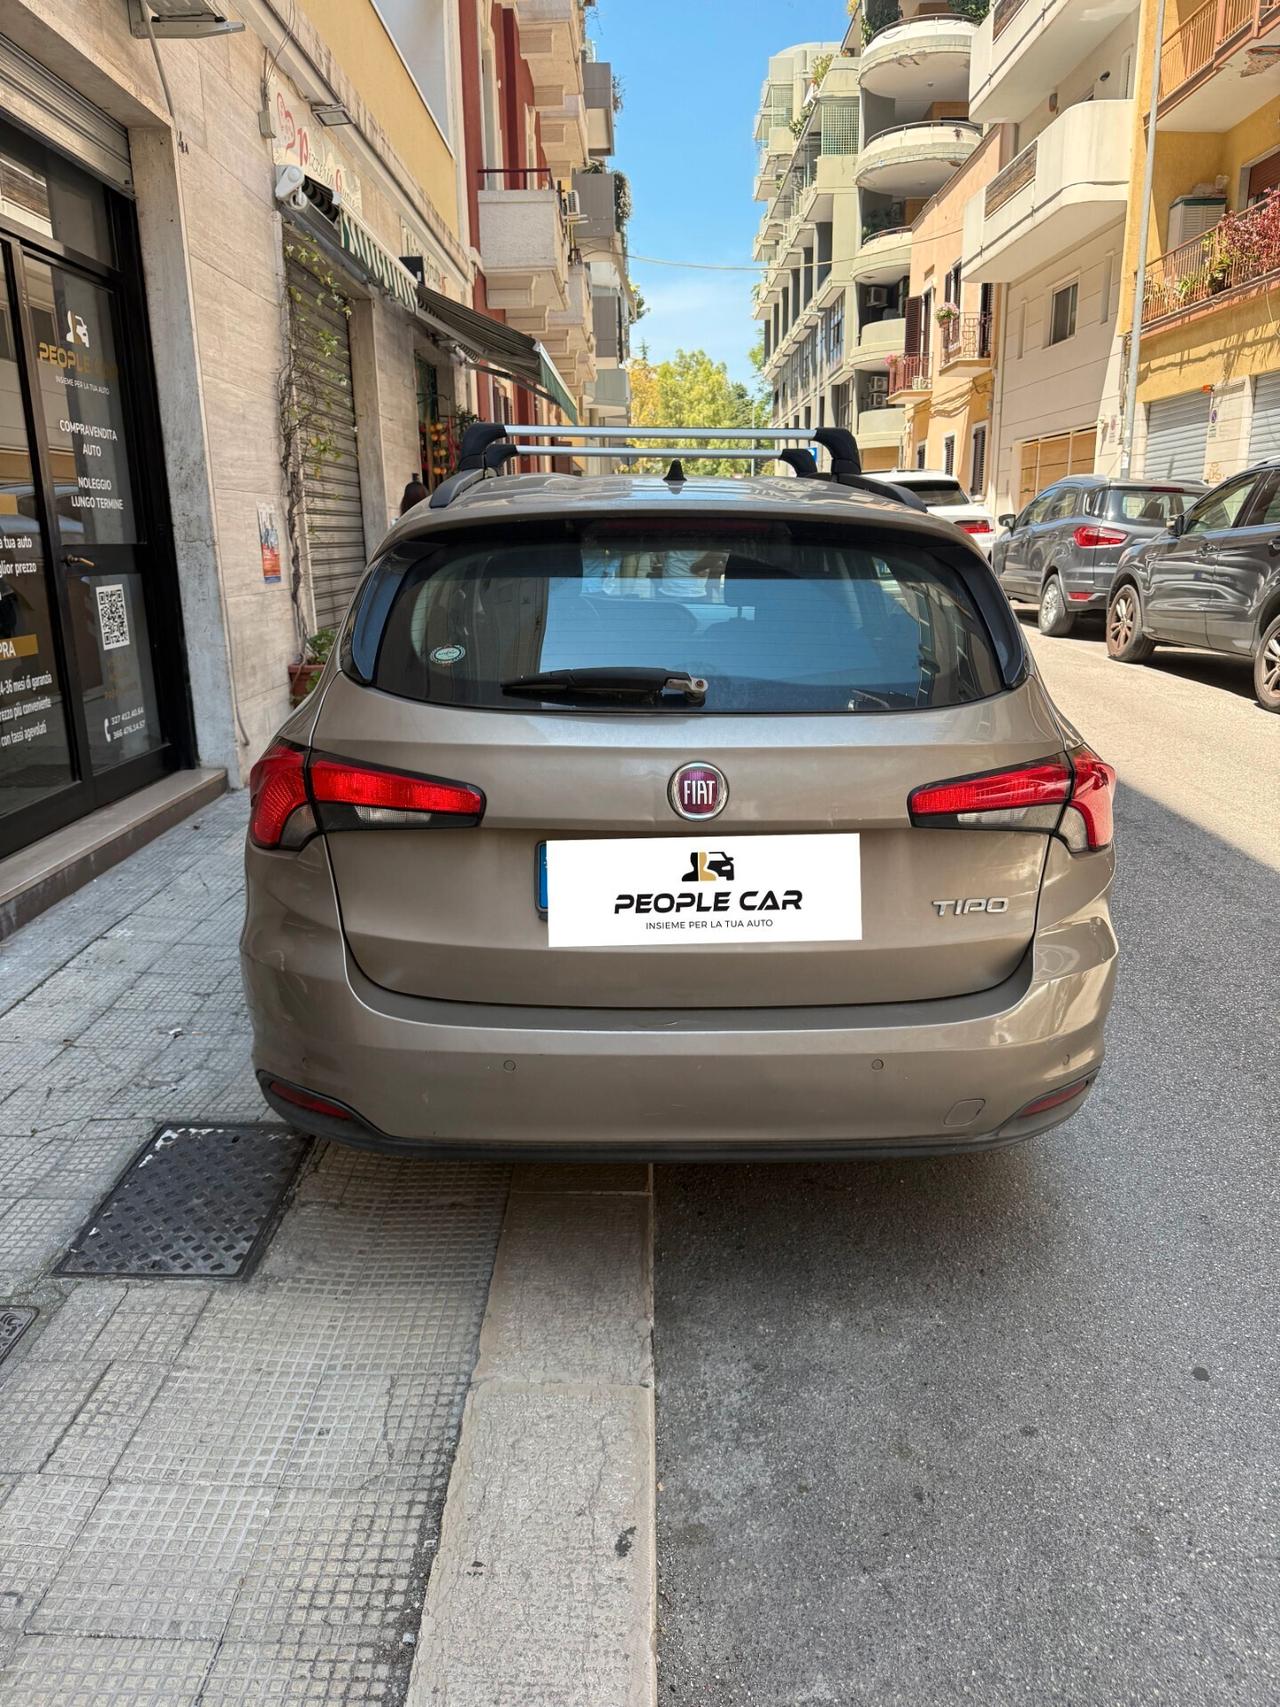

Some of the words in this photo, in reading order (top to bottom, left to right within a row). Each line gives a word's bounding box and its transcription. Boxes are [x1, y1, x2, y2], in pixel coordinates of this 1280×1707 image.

[60, 420, 117, 440] COMPRAVENDITA
[83, 443, 102, 457] AUTO
[78, 477, 112, 490] NOLEGGIO
[71, 496, 95, 508] LUNGO
[96, 498, 124, 510] TERMINE
[4, 535, 16, 549] tua
[16, 535, 32, 549] auto
[14, 562, 37, 577] prezzo
[13, 675, 26, 691] mesi
[26, 674, 32, 690] di
[32, 670, 53, 690] garanzia
[22, 696, 52, 715] conveniente
[11, 725, 24, 744] tassi
[24, 719, 47, 742] agevolati
[683, 780, 716, 805] FIAT
[932, 897, 1009, 916] TIPO
